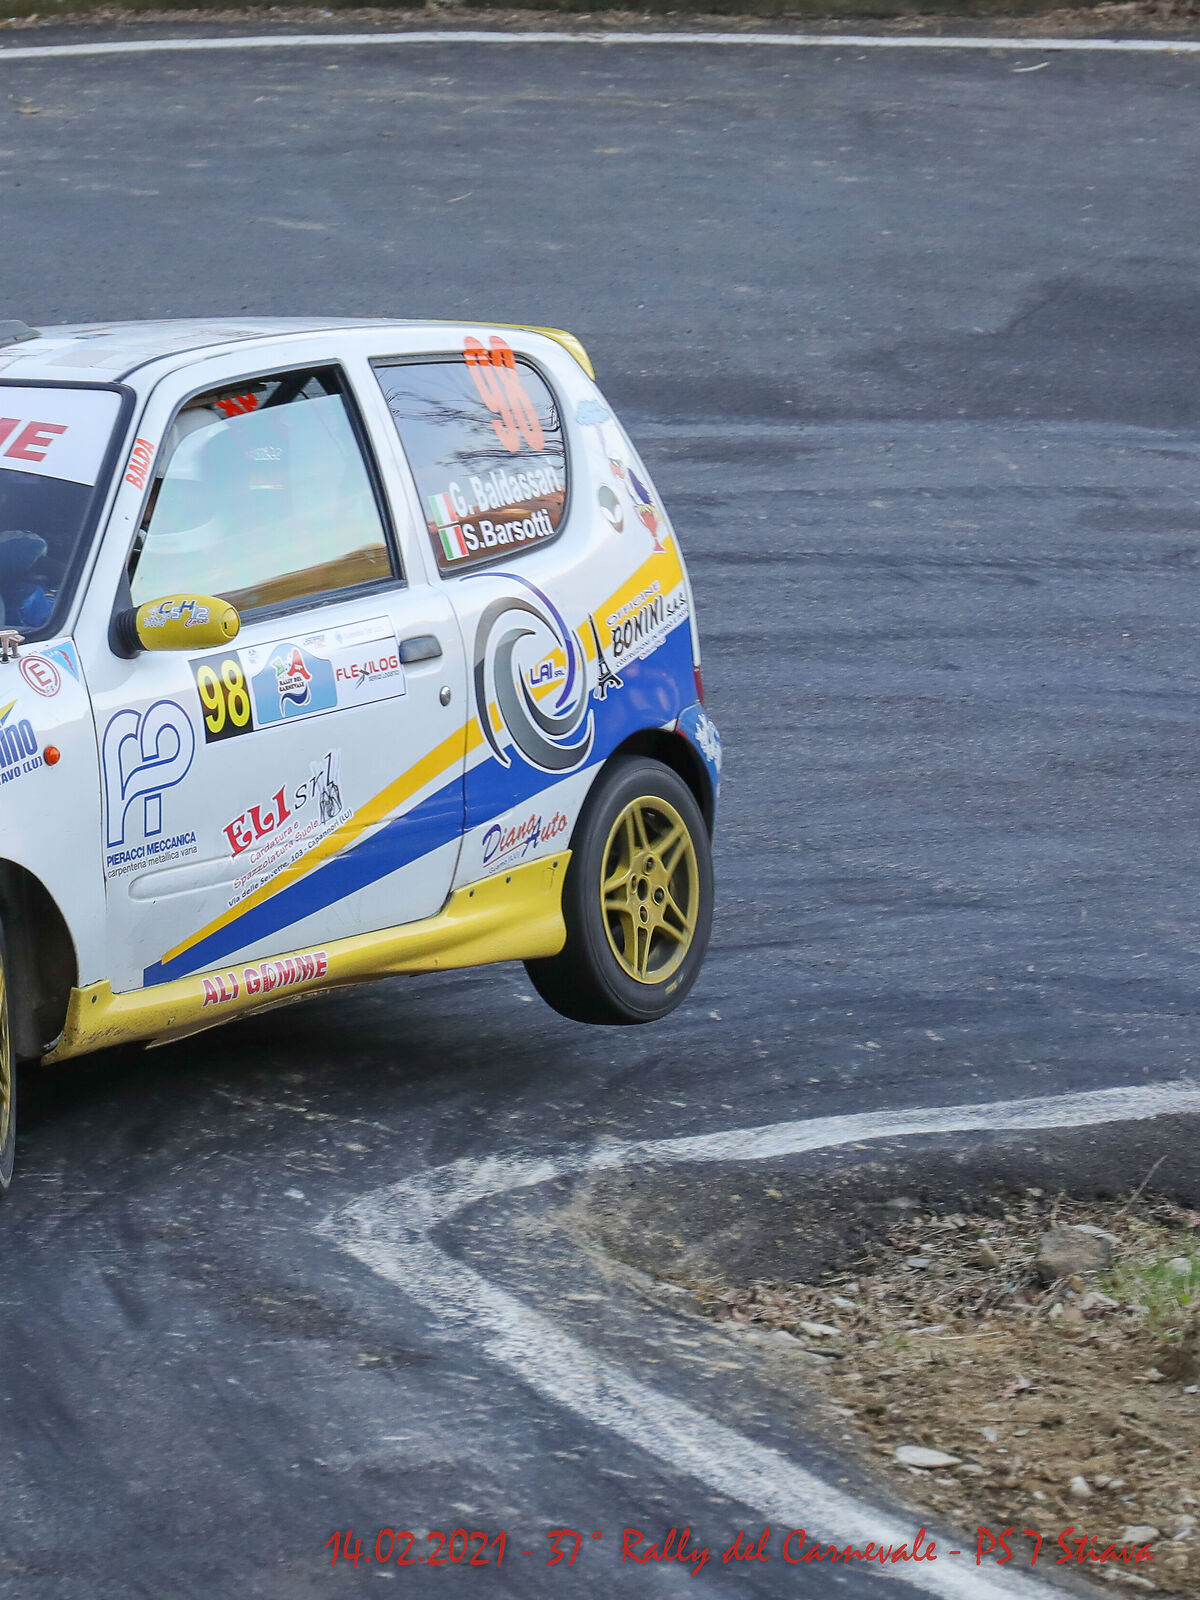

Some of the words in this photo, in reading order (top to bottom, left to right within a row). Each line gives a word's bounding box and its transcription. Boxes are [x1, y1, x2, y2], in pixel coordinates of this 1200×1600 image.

[464, 336, 544, 452] 98
[125, 438, 154, 490] BALDA
[449, 482, 475, 518] G.
[462, 508, 554, 551] S.Barsotti
[611, 594, 664, 657] BONINI
[29, 663, 52, 686] E
[336, 655, 399, 690] FLEXILOG
[530, 662, 552, 684] LAI
[197, 659, 250, 733] 98
[23, 756, 43, 773] (LU)
[223, 785, 291, 857] ELI
[107, 846, 145, 867] PIERACCI
[147, 832, 197, 855] MECCANICA
[108, 859, 146, 878] carpenteria
[148, 851, 179, 867] metallica
[181, 846, 197, 857] varia
[229, 895, 240, 907] Via
[242, 883, 259, 897] delle
[291, 850, 304, 862] 103
[308, 821, 340, 848] Capannori
[234, 841, 294, 888] Spazzolatura
[295, 820, 318, 841] Suole
[250, 826, 293, 863] Cardatura
[202, 972, 239, 1007] ALI
[244, 951, 328, 995] GOMME
